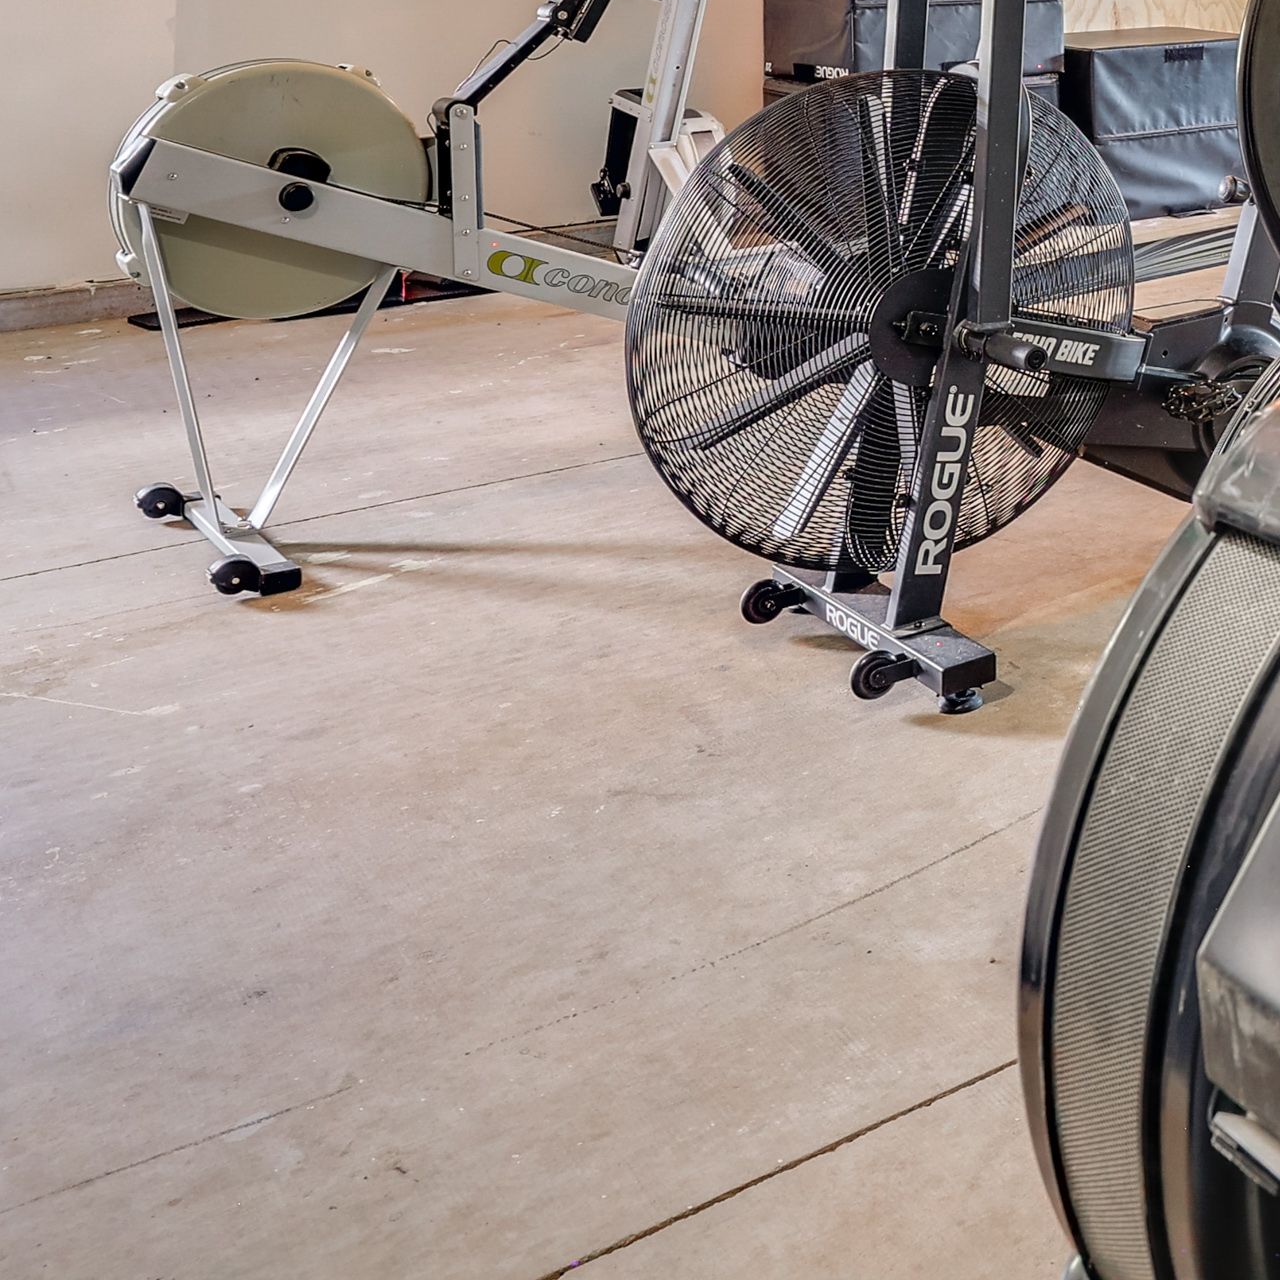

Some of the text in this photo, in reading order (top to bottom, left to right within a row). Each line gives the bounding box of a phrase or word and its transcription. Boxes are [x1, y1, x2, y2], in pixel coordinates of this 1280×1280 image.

[543, 267, 631, 306] conc
[1054, 339, 1100, 366] BIKE
[914, 392, 975, 576] ROGUE
[825, 602, 879, 651] ROGUE
